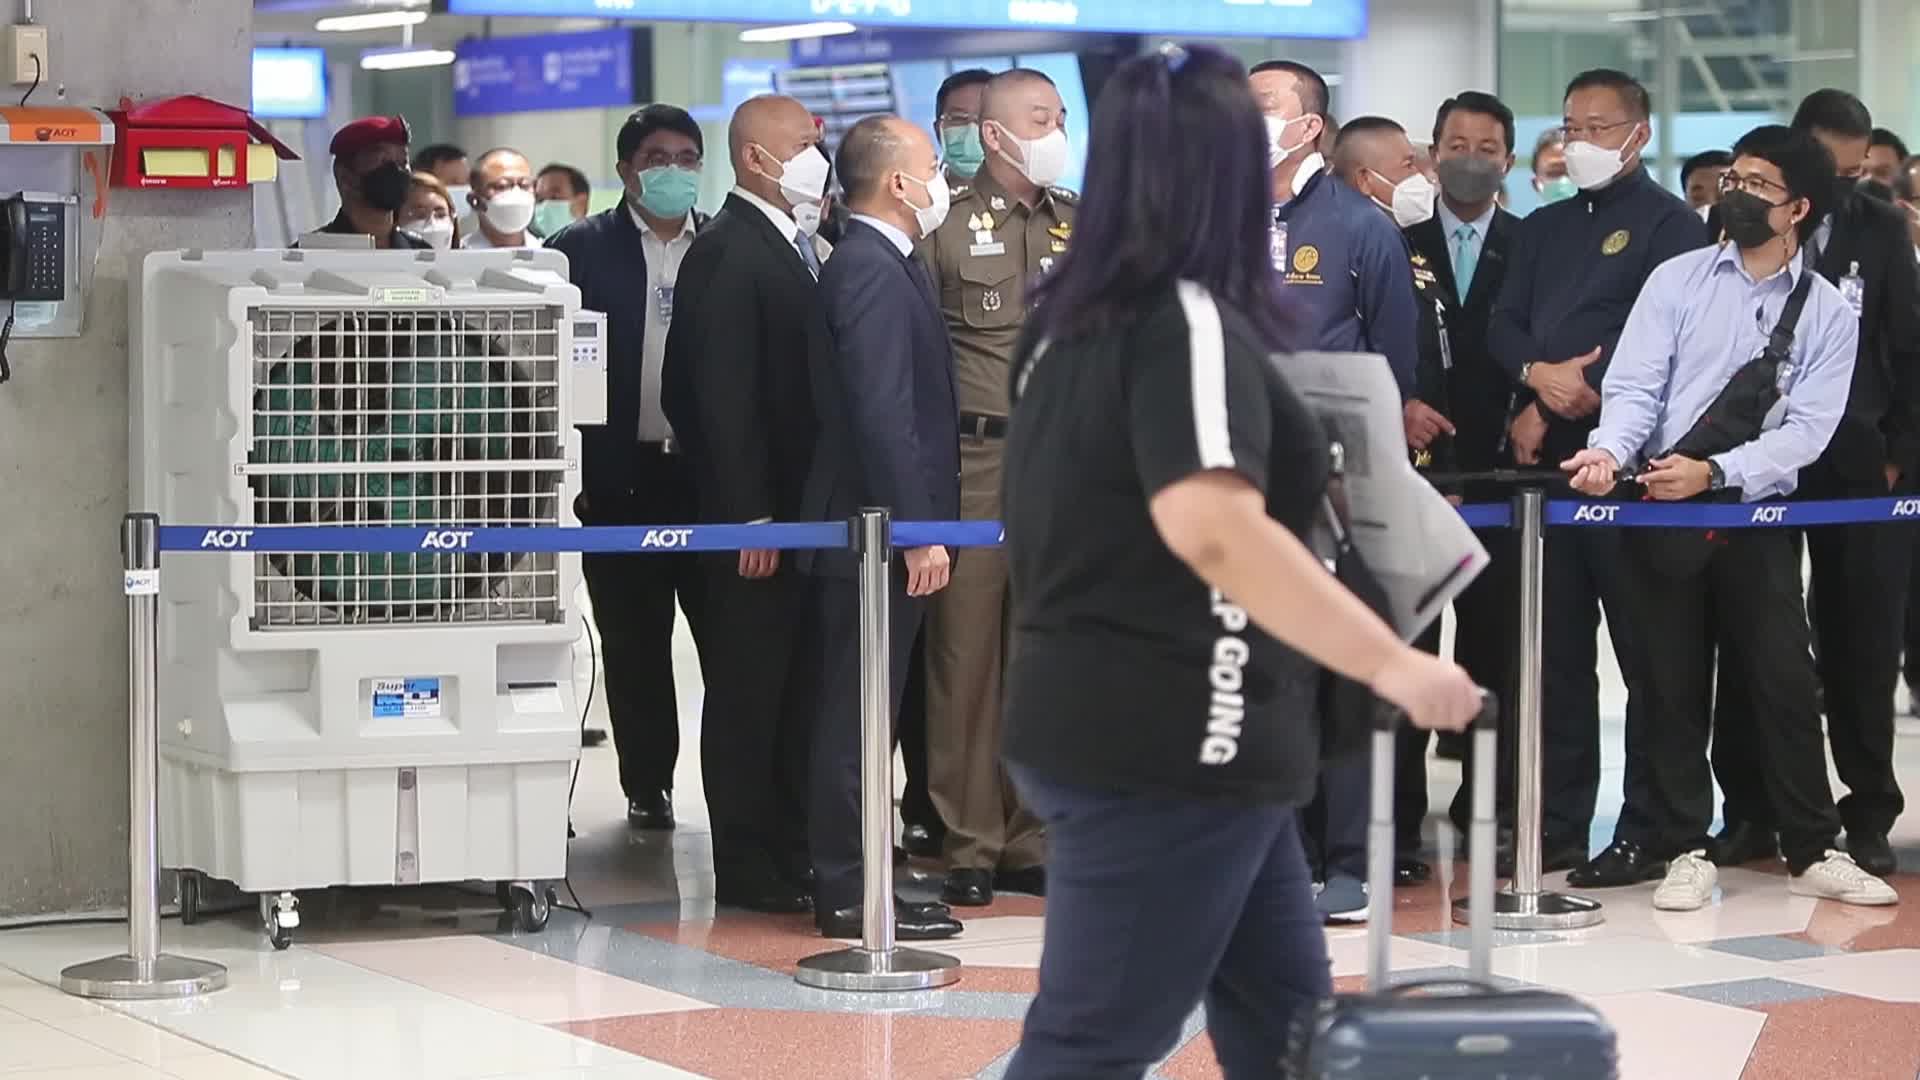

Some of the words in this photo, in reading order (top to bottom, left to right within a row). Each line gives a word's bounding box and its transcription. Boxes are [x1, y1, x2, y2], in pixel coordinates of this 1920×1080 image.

[1574, 505, 1620, 521] AOT
[1752, 506, 1788, 522] AOT
[201, 530, 253, 547] AOT
[421, 530, 473, 548] AOT
[641, 529, 693, 547] AOT
[1200, 636, 1250, 764] GOING
